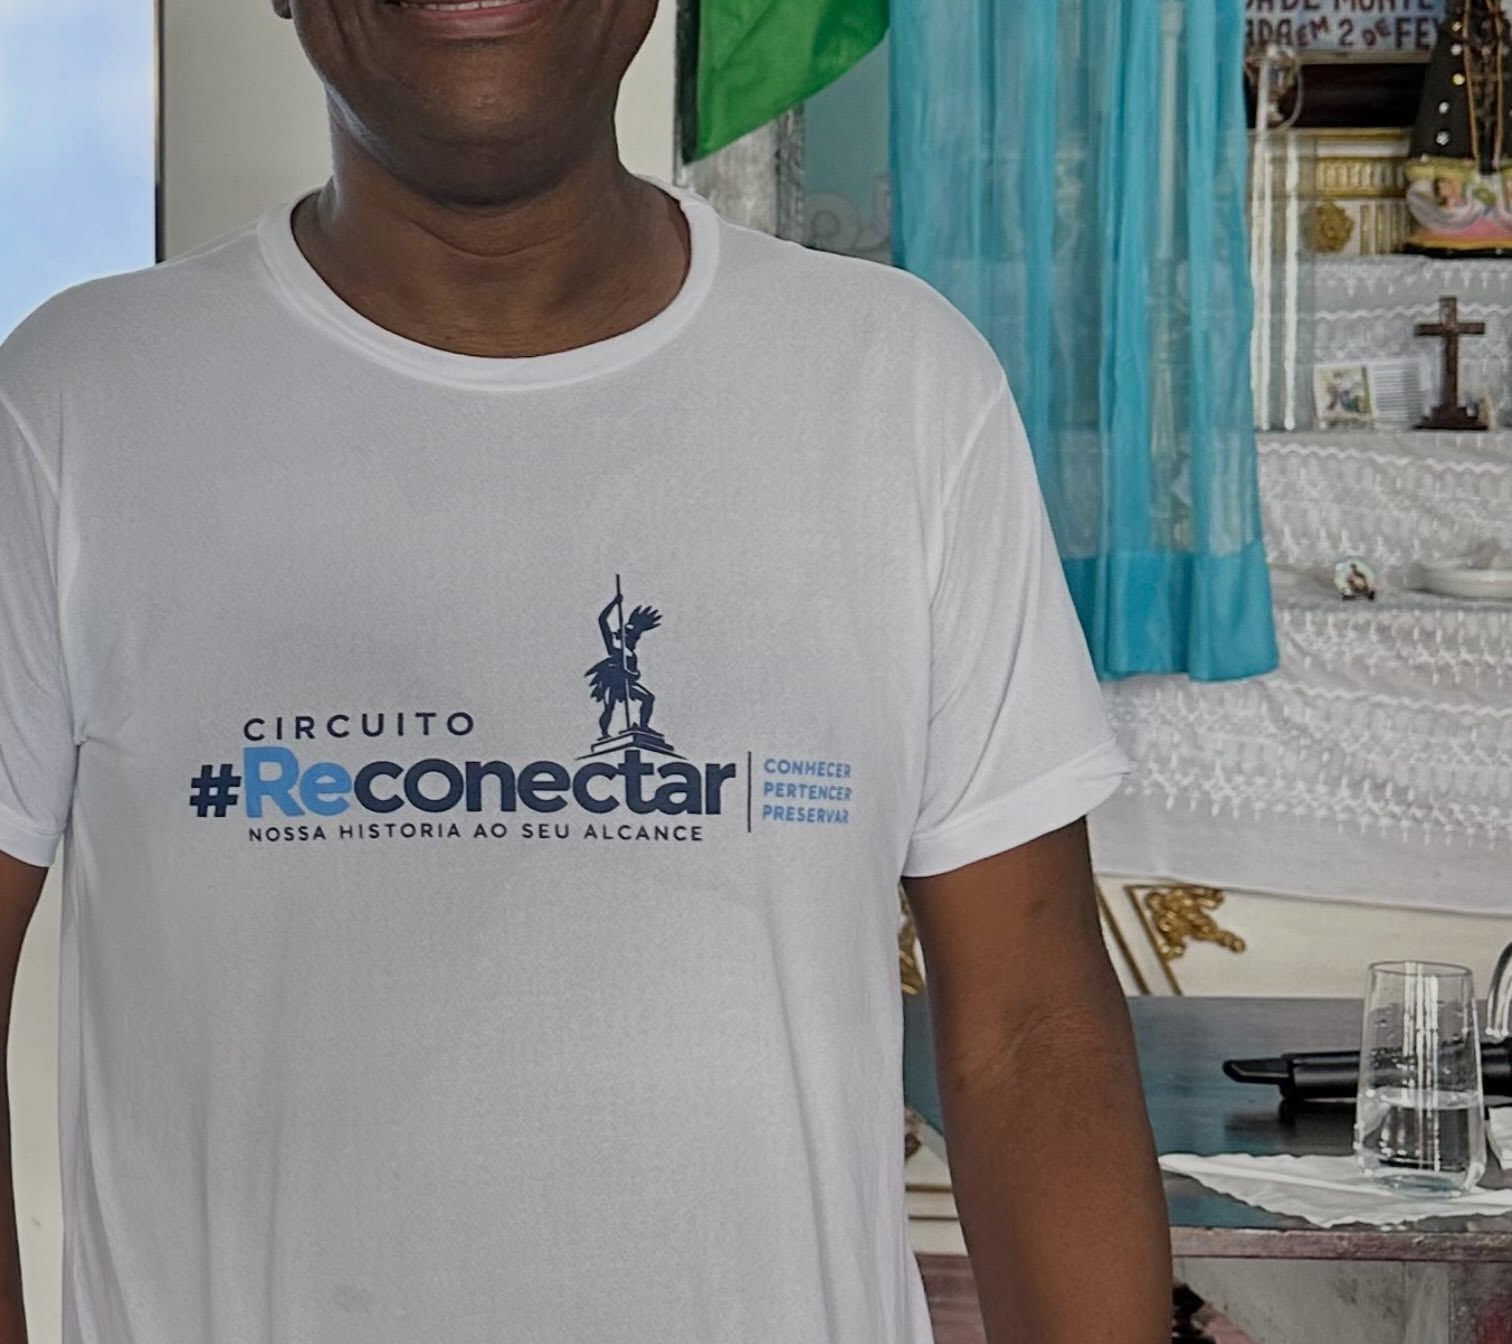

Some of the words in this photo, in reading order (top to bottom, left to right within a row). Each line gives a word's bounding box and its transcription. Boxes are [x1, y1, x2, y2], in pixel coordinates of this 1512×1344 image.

[1338, 18, 1354, 46] 2
[243, 711, 474, 742] CIRCUITO
[763, 758, 852, 779] CONHECER
[188, 746, 737, 819] #Reconectar
[763, 781, 853, 802] PERTENCER
[762, 803, 849, 824] PRESERVAR
[248, 825, 327, 843] NOSSA
[339, 822, 461, 841] HISTORIA
[472, 822, 508, 840] AO
[521, 822, 570, 840] SEU
[583, 823, 703, 842] ALCANCE
